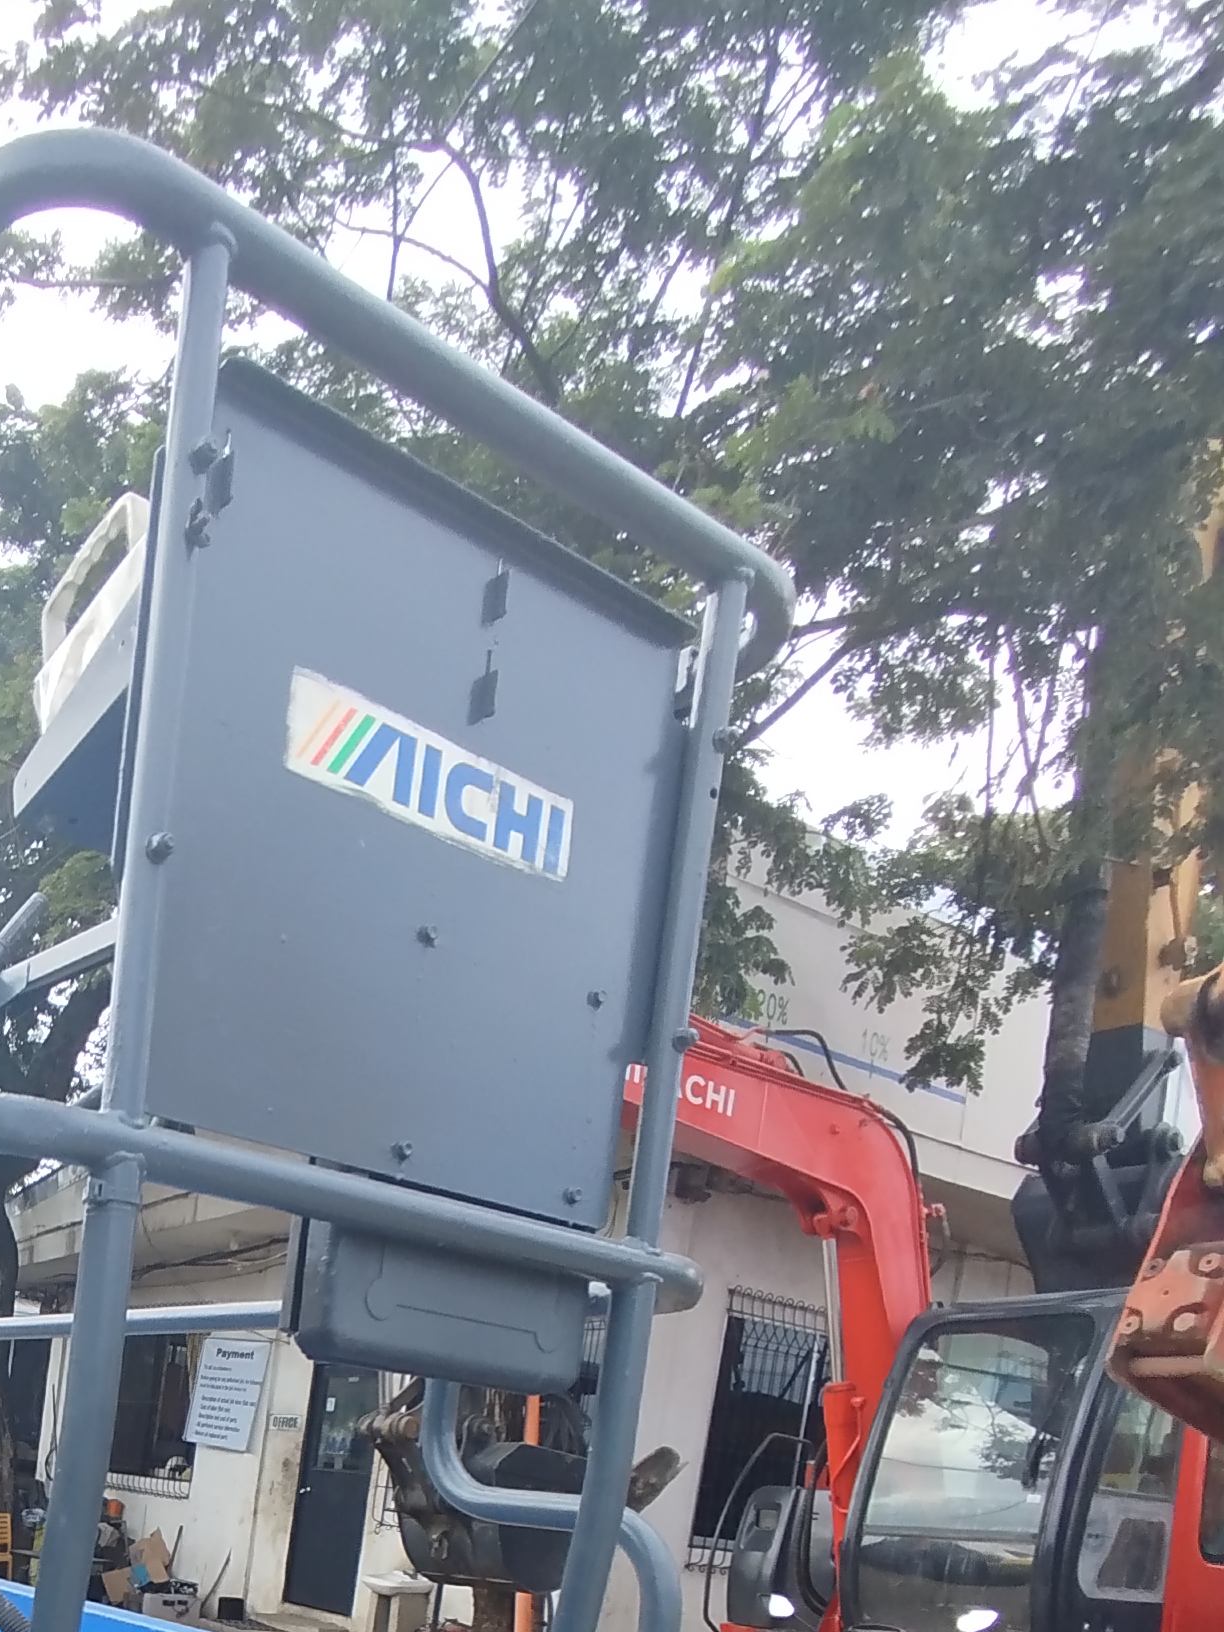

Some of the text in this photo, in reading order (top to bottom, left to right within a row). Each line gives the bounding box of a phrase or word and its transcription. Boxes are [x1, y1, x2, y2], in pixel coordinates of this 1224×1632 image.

[343, 721, 566, 876] AICHI
[861, 1028, 892, 1062] 10%
[216, 1348, 255, 1360] Payment
[272, 1415, 299, 1429] OFFICE
